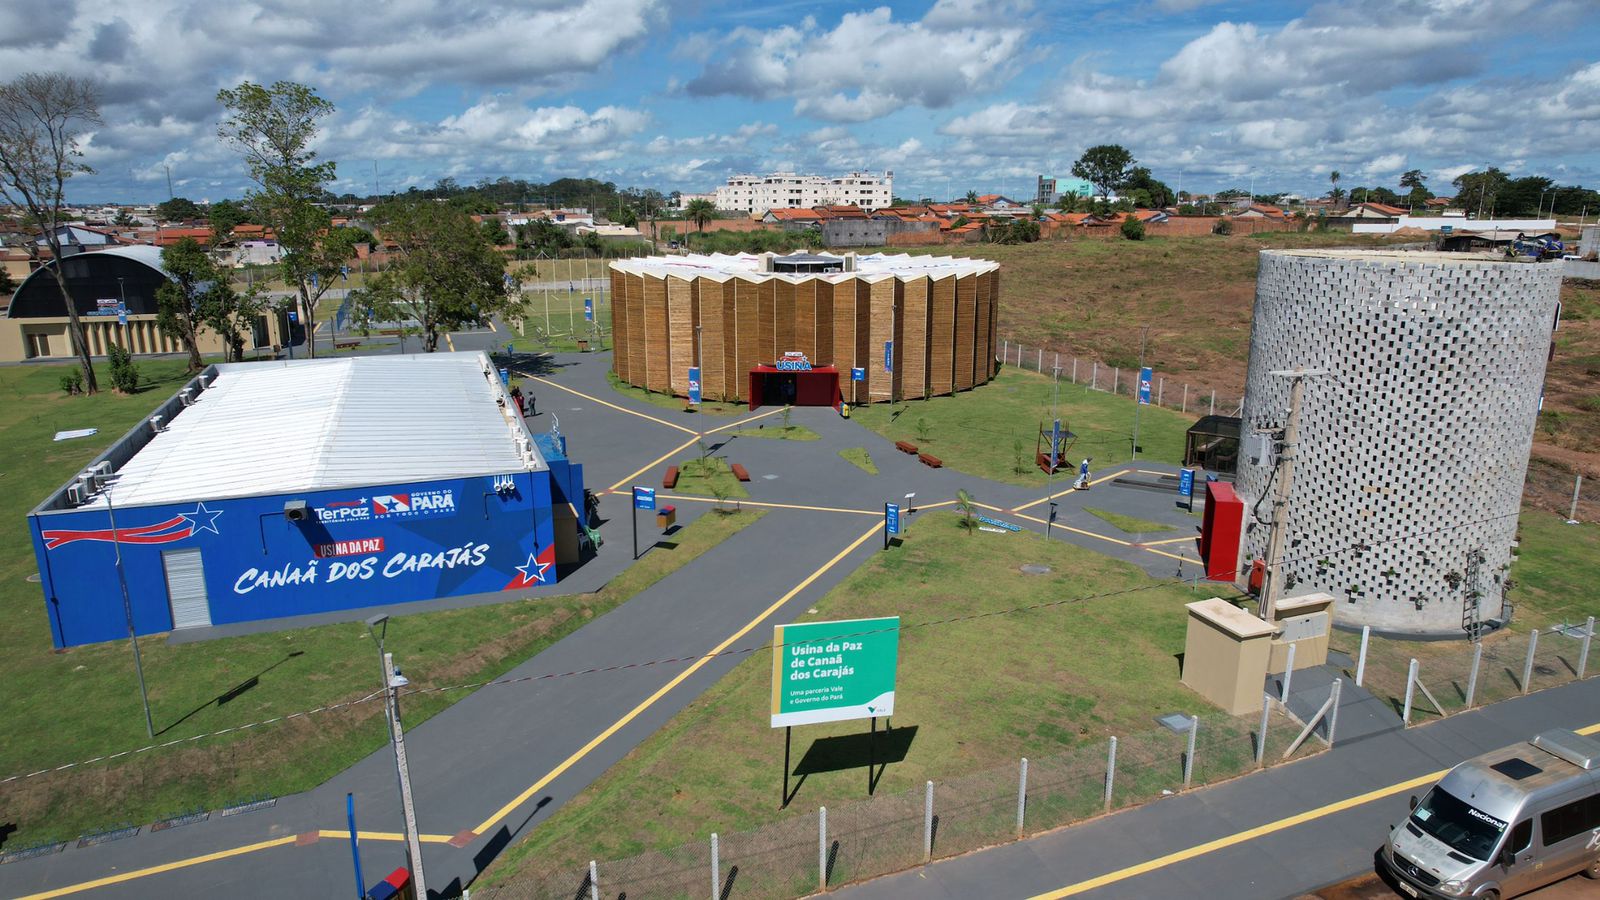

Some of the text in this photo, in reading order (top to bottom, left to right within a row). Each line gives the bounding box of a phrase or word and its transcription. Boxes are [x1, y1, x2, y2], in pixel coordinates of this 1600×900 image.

[776, 361, 812, 371] USINA
[314, 507, 369, 520] TerPaz
[320, 539, 380, 557] USINA DA PAZ
[233, 542, 490, 595] CANAÃ DOS CARAJÁS
[792, 641, 863, 656] Usina da Paz
[790, 654, 843, 668] de Canaã
[790, 665, 854, 681] dos Carajás
[805, 686, 830, 696] parceria
[794, 696, 820, 704] Governo
[1468, 808, 1507, 829] Nacional
